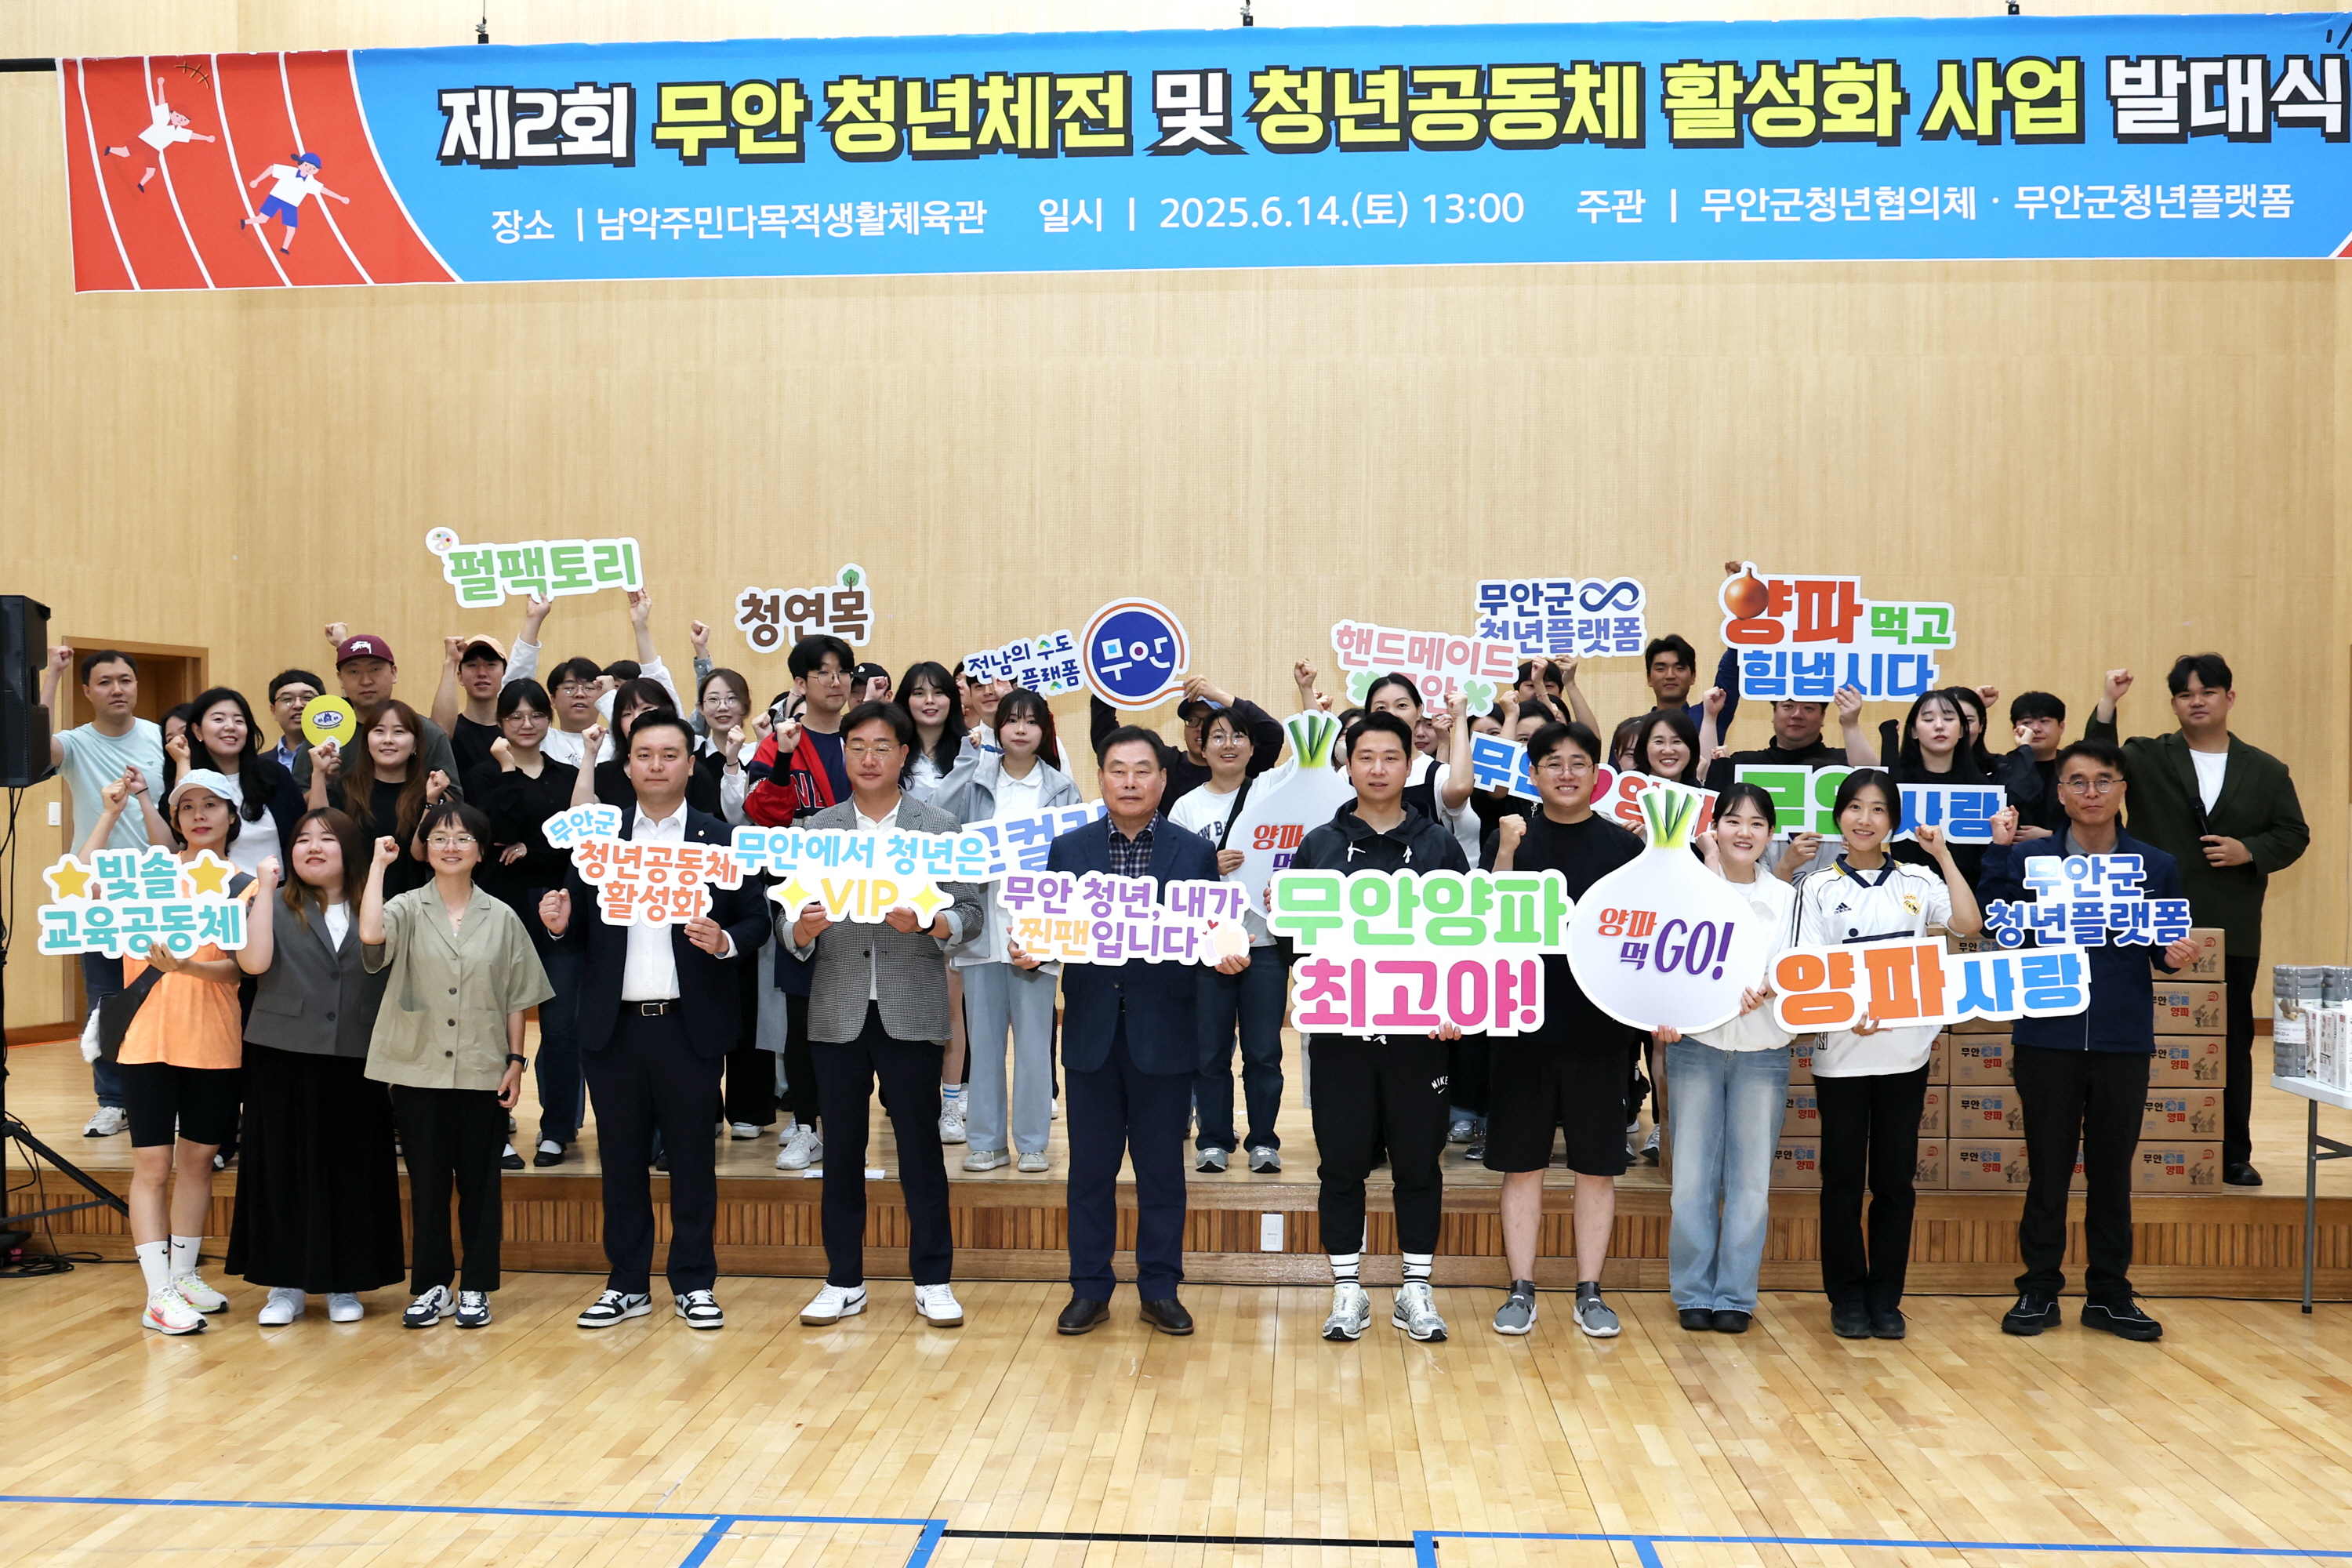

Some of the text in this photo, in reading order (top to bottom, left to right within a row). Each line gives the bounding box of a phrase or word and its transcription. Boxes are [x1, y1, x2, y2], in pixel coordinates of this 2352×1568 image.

[437, 54, 2350, 167] 제2회 무안 청년체전 및 청년공동체 활성화 사업 발대식
[492, 183, 2295, 244] 장소 남악주민다목적생활체육관 일시 2025.6.14.(토) 13:00 주관 무안군청년협의체 무안군청년플랫폼
[448, 544, 636, 601] 펄팩토리
[1479, 583, 1573, 617] 무안군
[1725, 579, 1951, 645] 양파 먹고
[740, 592, 868, 648] 청연목
[968, 635, 1073, 679] 전남의 수도
[1100, 636, 1171, 681] 무안
[1336, 624, 1514, 679] 핸드메이드
[1744, 650, 1933, 698] 힘냅시다
[548, 808, 615, 843] 무안군
[1253, 825, 1305, 850] 양파
[578, 840, 737, 887] 청년공동체
[735, 832, 874, 869] 무안에서
[886, 833, 986, 876] 청년은
[97, 852, 177, 901] 빛솔
[2025, 855, 2144, 898] 무안군
[604, 884, 706, 921] 활성화
[821, 877, 899, 917] VIP
[1004, 877, 1244, 921] 무안 청년, 내가
[1275, 876, 1567, 946] 무안양파
[45, 904, 241, 953] 교육공동체
[1018, 918, 1198, 959] 찐팬입니다
[1598, 908, 1657, 938] 양파
[1986, 901, 2190, 946] 청년플랫폼
[1959, 942, 1977, 952] 무안
[1299, 957, 1537, 1029] 최고야!
[2170, 1007, 2190, 1017] 양파
[1962, 1047, 1980, 1057] 무안
[1984, 1058, 2002, 1068] 양파
[2170, 1060, 2190, 1070] 양파
[1431, 1076, 1449, 1090] NIKE
[1798, 1109, 1817, 1120] 양파
[1961, 1100, 1980, 1109] 무안
[1984, 1111, 2002, 1120] 양파
[2144, 1102, 2164, 1112] 무안
[2167, 1113, 2186, 1123] 양파
[1774, 1150, 1793, 1160] 무안
[1796, 1160, 1815, 1170] 양파
[1960, 1152, 1979, 1162] 무안
[1982, 1163, 2002, 1173] 양파
[2143, 1154, 2162, 1163] 무안
[2165, 1165, 2185, 1175] 양파
